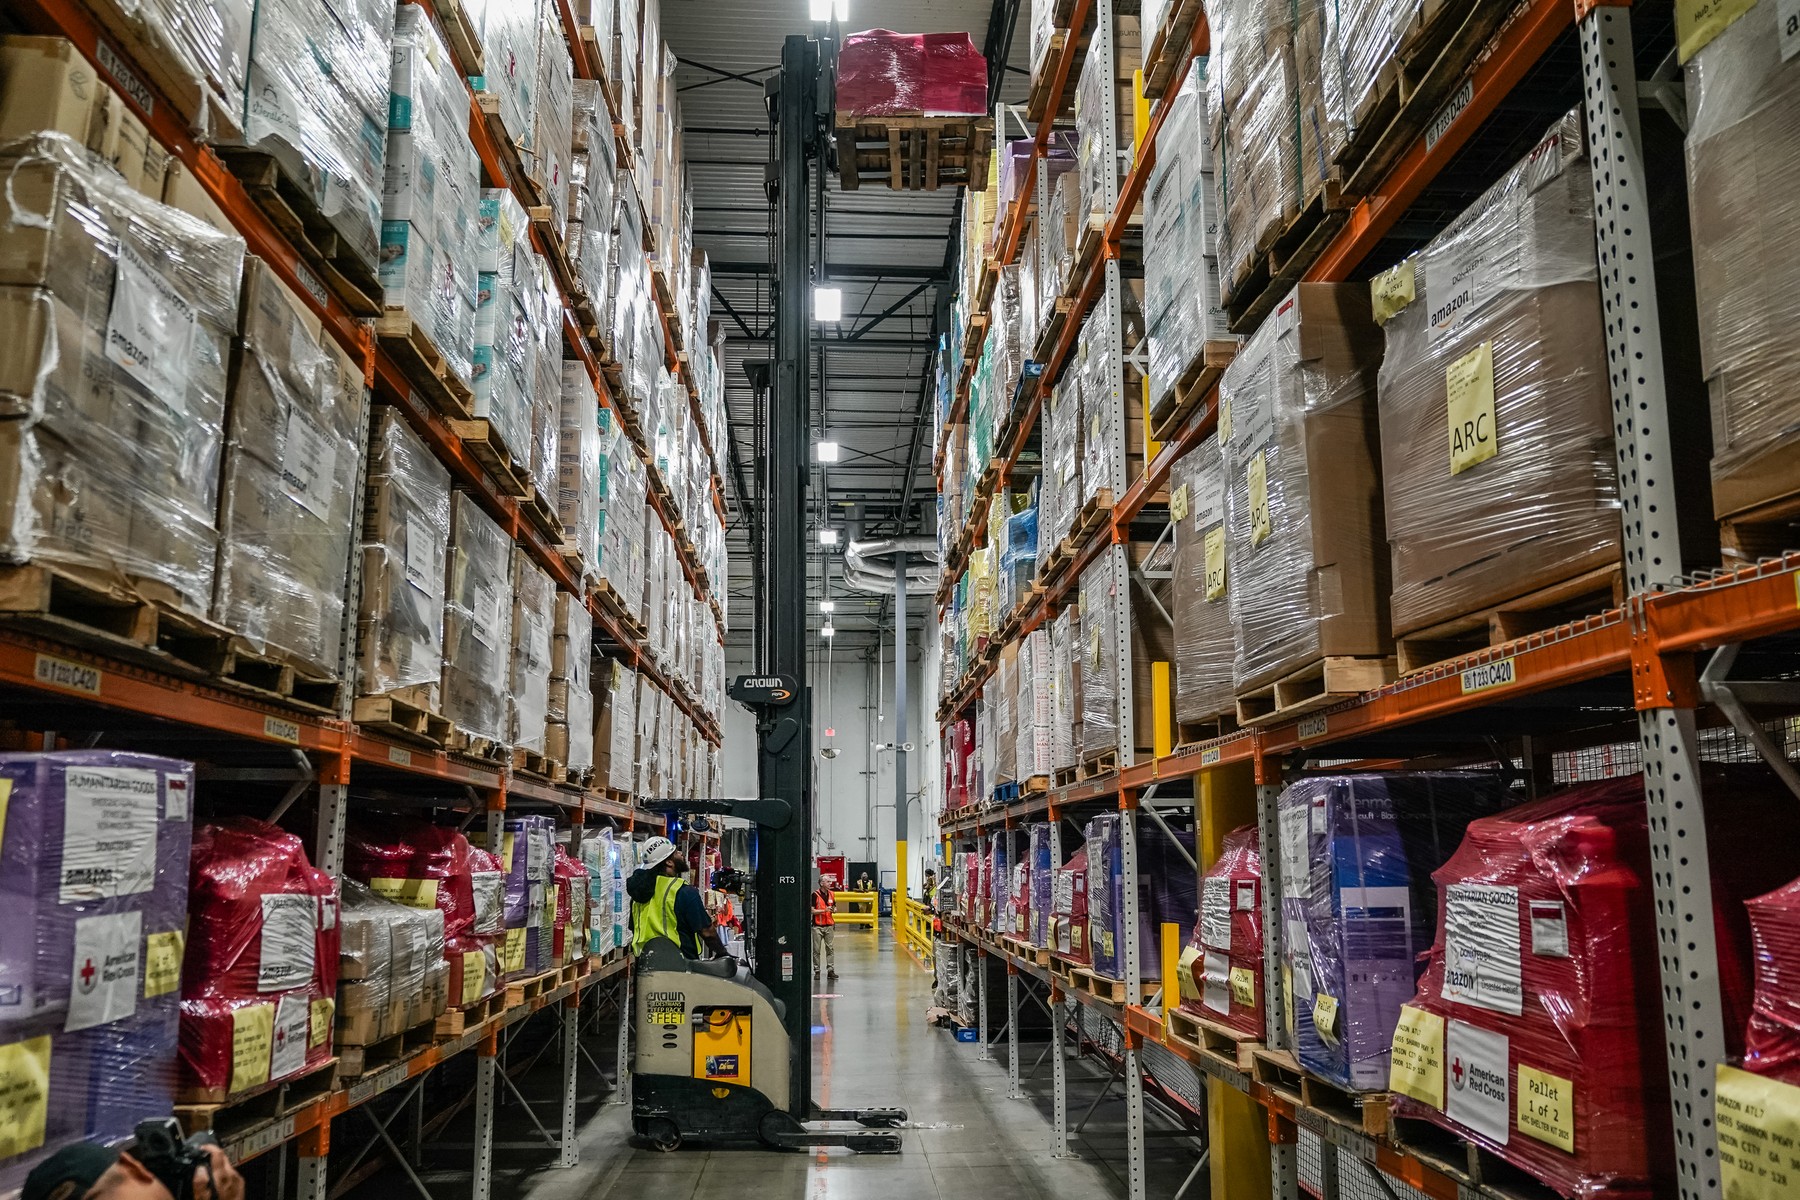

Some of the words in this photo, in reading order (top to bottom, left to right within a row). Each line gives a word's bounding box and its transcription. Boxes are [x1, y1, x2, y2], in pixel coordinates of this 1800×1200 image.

[1450, 86, 1470, 120] D420
[1431, 289, 1469, 327] amazon
[111, 329, 149, 369] amazon
[1452, 412, 1488, 457] ARC
[1251, 502, 1266, 534] ARC
[1207, 568, 1222, 592] ARC
[744, 678, 783, 688] CROWN
[1477, 669, 1489, 687] 233
[1489, 660, 1511, 683] C420
[1313, 717, 1326, 734] C425
[779, 876, 795, 884] RT3
[1489, 893, 1517, 905] GOODS
[646, 992, 685, 1001] CROWN
[646, 1014, 654, 1024] 8
[656, 1013, 684, 1024] FEET
[1430, 1046, 1435, 1055] S
[1469, 1063, 1505, 1087] American
[1469, 1078, 1483, 1093] Red
[1483, 1082, 1505, 1102] Cross
[1529, 1079, 1558, 1101] Pallet
[1529, 1101, 1533, 1112] 1
[1538, 1106, 1548, 1117] of
[1554, 1109, 1559, 1122] 2
[1745, 1105, 1764, 1118] ATL7
[1521, 1114, 1530, 1123] ARC
[1530, 1117, 1550, 1132] SHELTER
[1550, 1126, 1558, 1135] KIT
[1717, 1112, 1733, 1128] 6855
[1736, 1120, 1768, 1141] SHANNON
[1772, 1132, 1794, 1149] PKWY
[1741, 1141, 1761, 1155] CITY
[1769, 1151, 1779, 1163] GA
[1739, 1158, 1754, 1173] 122
[1758, 1167, 1767, 1177] or
[1771, 1171, 1788, 1187] 128
